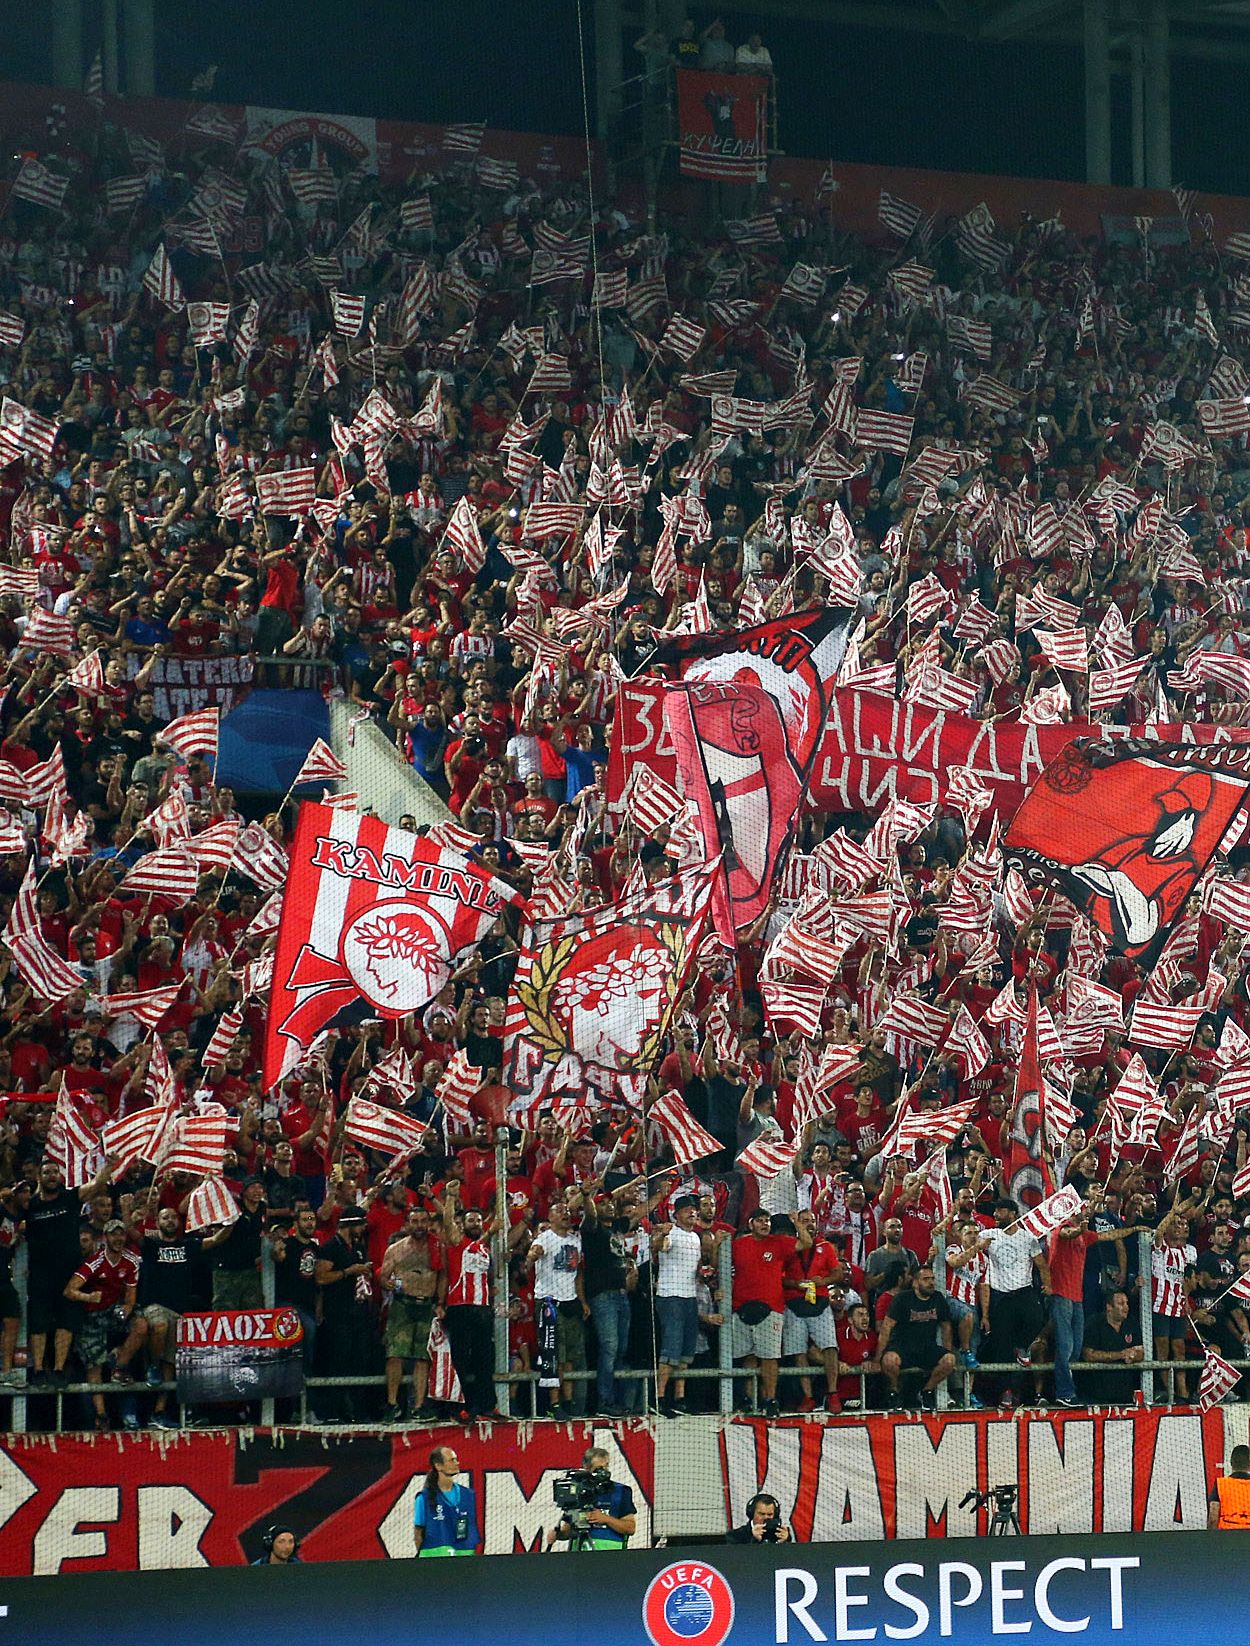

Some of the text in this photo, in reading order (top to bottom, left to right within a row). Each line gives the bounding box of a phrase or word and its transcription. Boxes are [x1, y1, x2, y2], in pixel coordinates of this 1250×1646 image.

[176, 1313, 273, 1343] ΠΥΛΟΣ
[659, 1556, 1141, 1644] UEFA RESPECT
